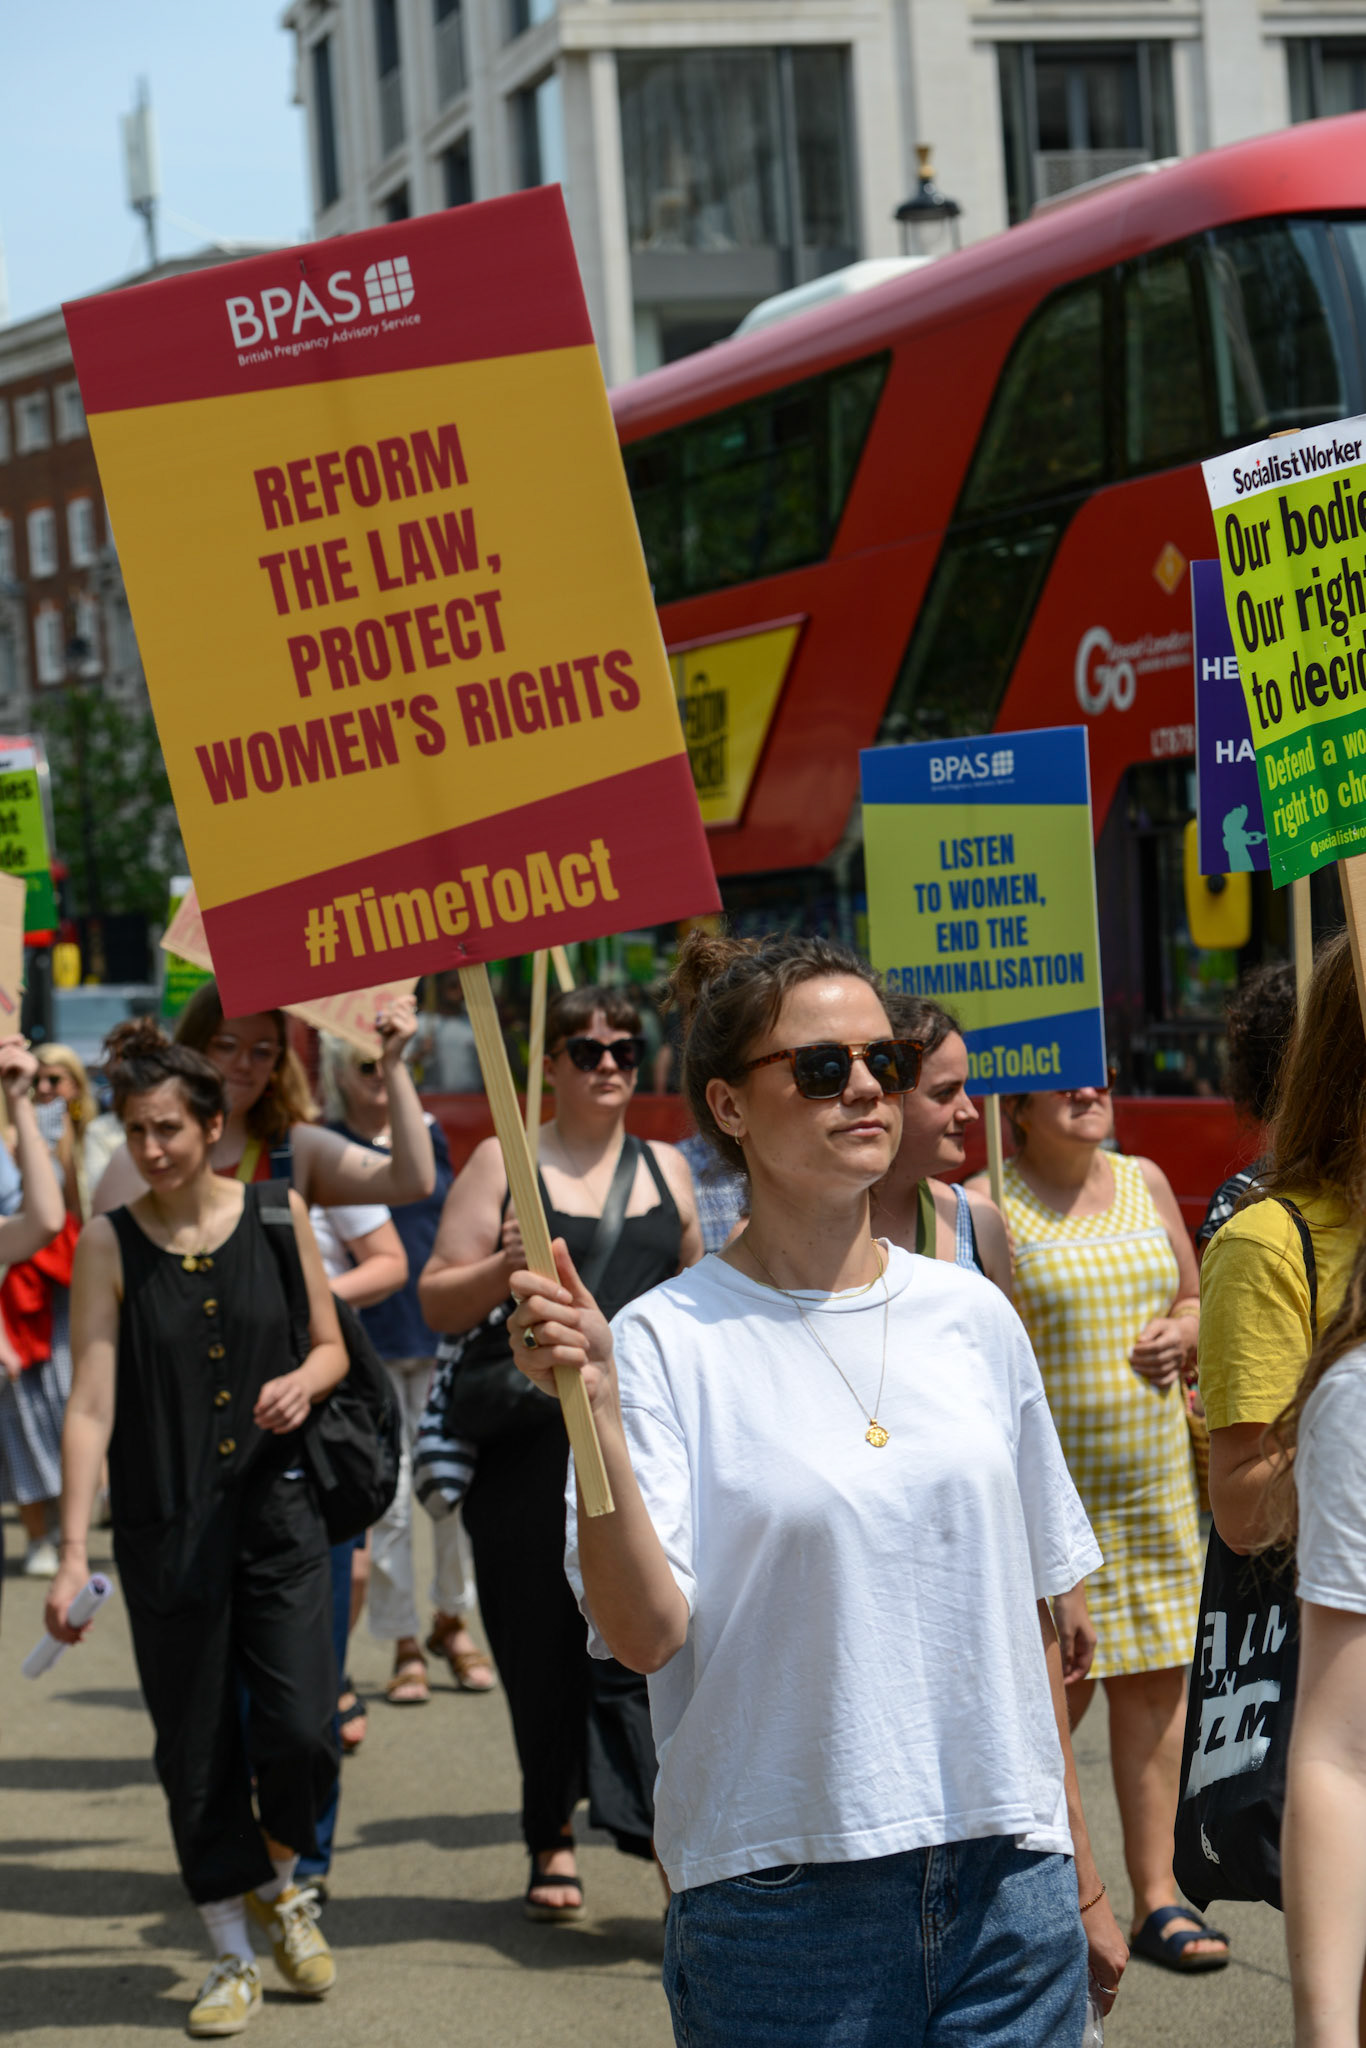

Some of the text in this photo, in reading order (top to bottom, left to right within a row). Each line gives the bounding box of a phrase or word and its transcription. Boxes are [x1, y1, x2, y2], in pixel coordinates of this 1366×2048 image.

[225, 270, 362, 349] BPAS
[238, 313, 421, 367] British Pregnancy Advisory Service
[253, 422, 469, 531] REFORM
[258, 507, 501, 616] THE LAW,
[1225, 513, 1271, 577] Our
[1236, 556, 1366, 653] Our righ
[287, 589, 506, 698] PROTECT
[1074, 625, 1136, 716] Go
[194, 694, 447, 806] WOMEN'S
[456, 648, 641, 748] RIGHTS
[1252, 671, 1283, 730] to
[930, 752, 990, 784] BPAS
[1264, 735, 1316, 791] Defend
[1321, 739, 1338, 766] a
[1273, 786, 1310, 838] right
[1310, 784, 1329, 818] to
[939, 833, 1015, 871] LISTEN
[304, 838, 620, 967] #TimeToAct
[914, 872, 1046, 914] TO WOMEN,
[936, 915, 1029, 954] END THE
[885, 952, 1085, 996] CRIMINALISATION
